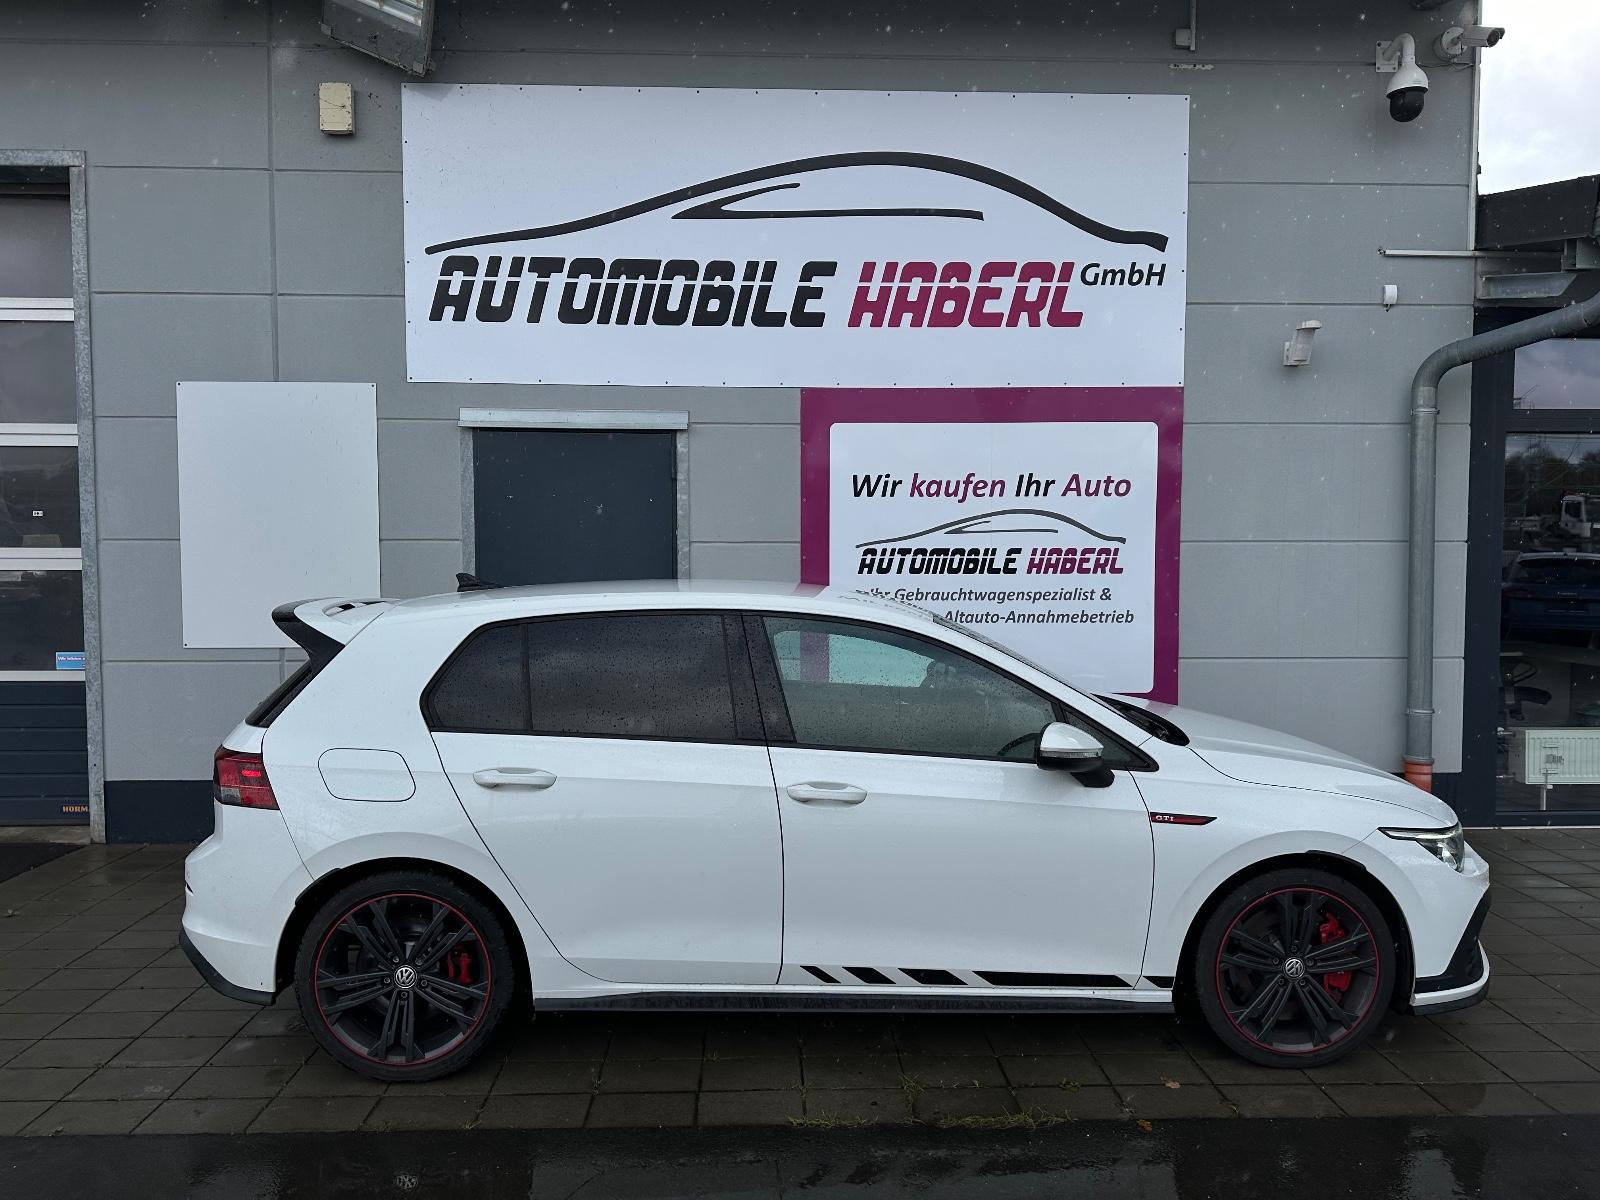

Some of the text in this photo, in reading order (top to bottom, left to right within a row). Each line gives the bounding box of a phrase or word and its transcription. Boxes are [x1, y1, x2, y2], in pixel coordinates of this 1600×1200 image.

[429, 255, 1167, 328] AUTOMOBILE HABERL GmbH
[852, 472, 1132, 503] Wir kaufen Ihr Auto
[857, 547, 1124, 575] AUTOMOBILE HABERL
[894, 587, 1095, 604] Gebrauchtwagenspezialist
[1099, 587, 1112, 601] &
[944, 609, 1135, 625] Altauto-Annahmebetrieb
